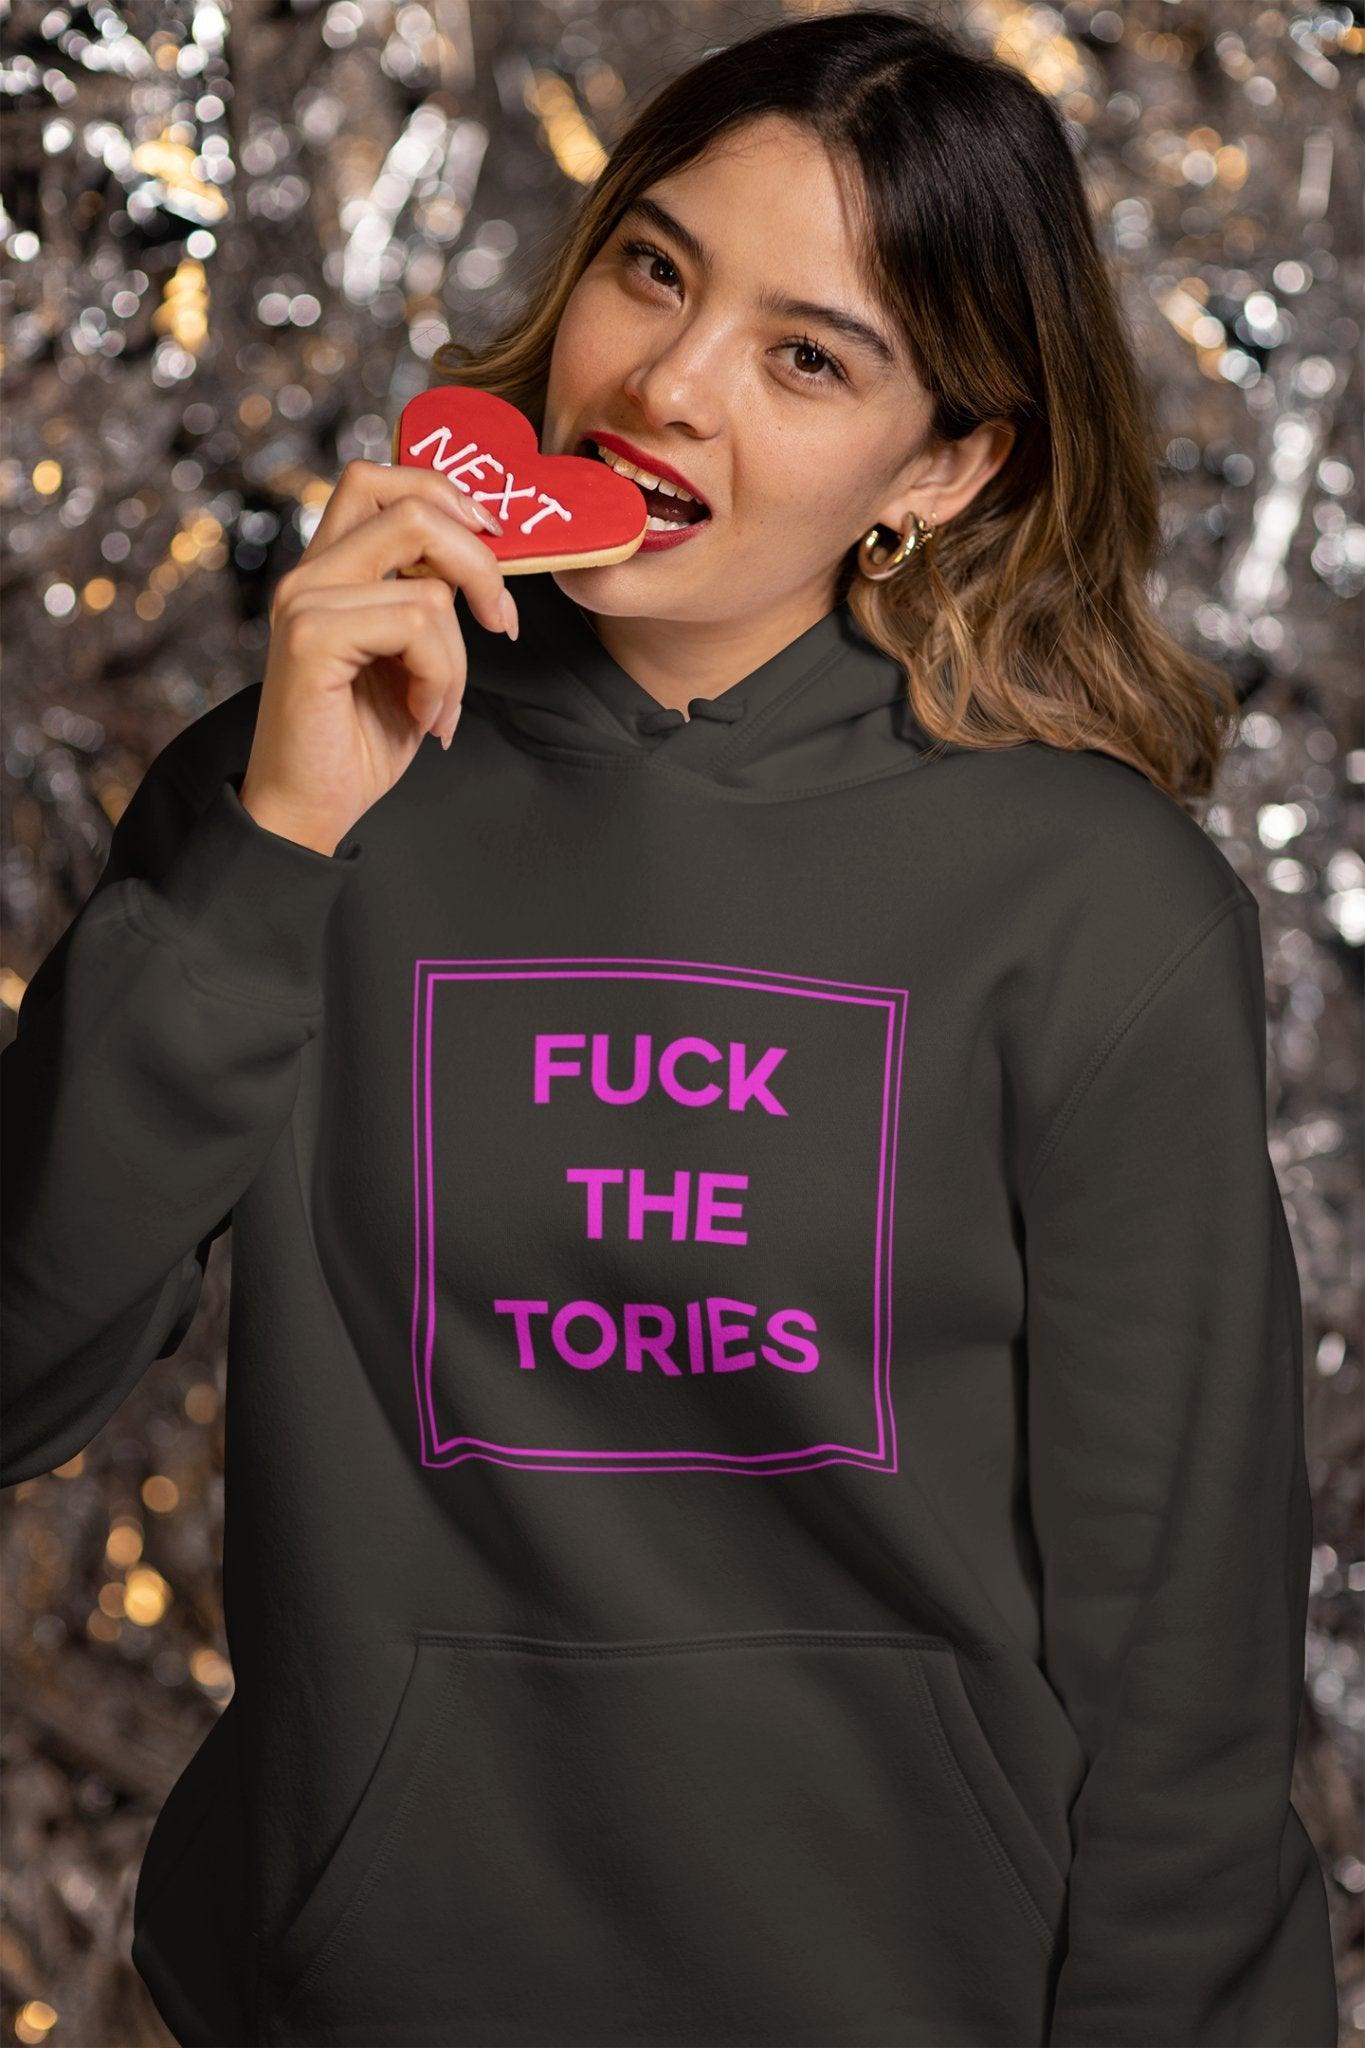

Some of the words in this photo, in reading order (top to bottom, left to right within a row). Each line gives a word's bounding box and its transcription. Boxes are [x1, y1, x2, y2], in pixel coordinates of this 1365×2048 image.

[409, 426, 572, 534] NEXT
[533, 1034, 789, 1117] FUCK
[566, 1168, 749, 1246] THE
[494, 1297, 821, 1376] TORIES
